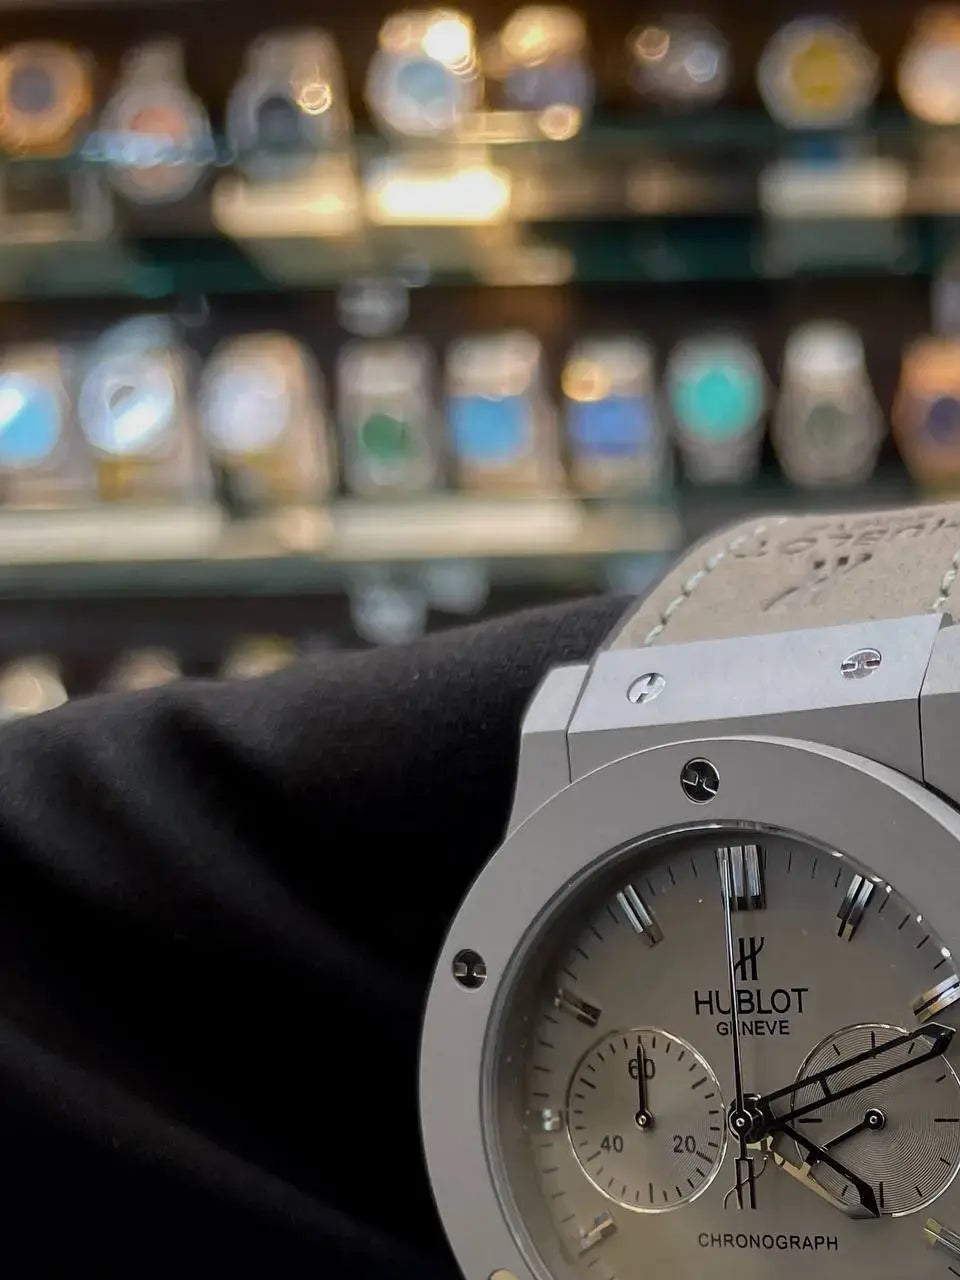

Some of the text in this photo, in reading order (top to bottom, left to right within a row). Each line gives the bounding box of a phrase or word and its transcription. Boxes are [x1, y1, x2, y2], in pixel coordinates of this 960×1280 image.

[694, 987, 809, 1016] HUBLOT
[628, 1058, 656, 1080] 60
[600, 1134, 624, 1153] 40
[673, 1135, 697, 1154] 20
[698, 1232, 838, 1251] CHRONOGRAPH
